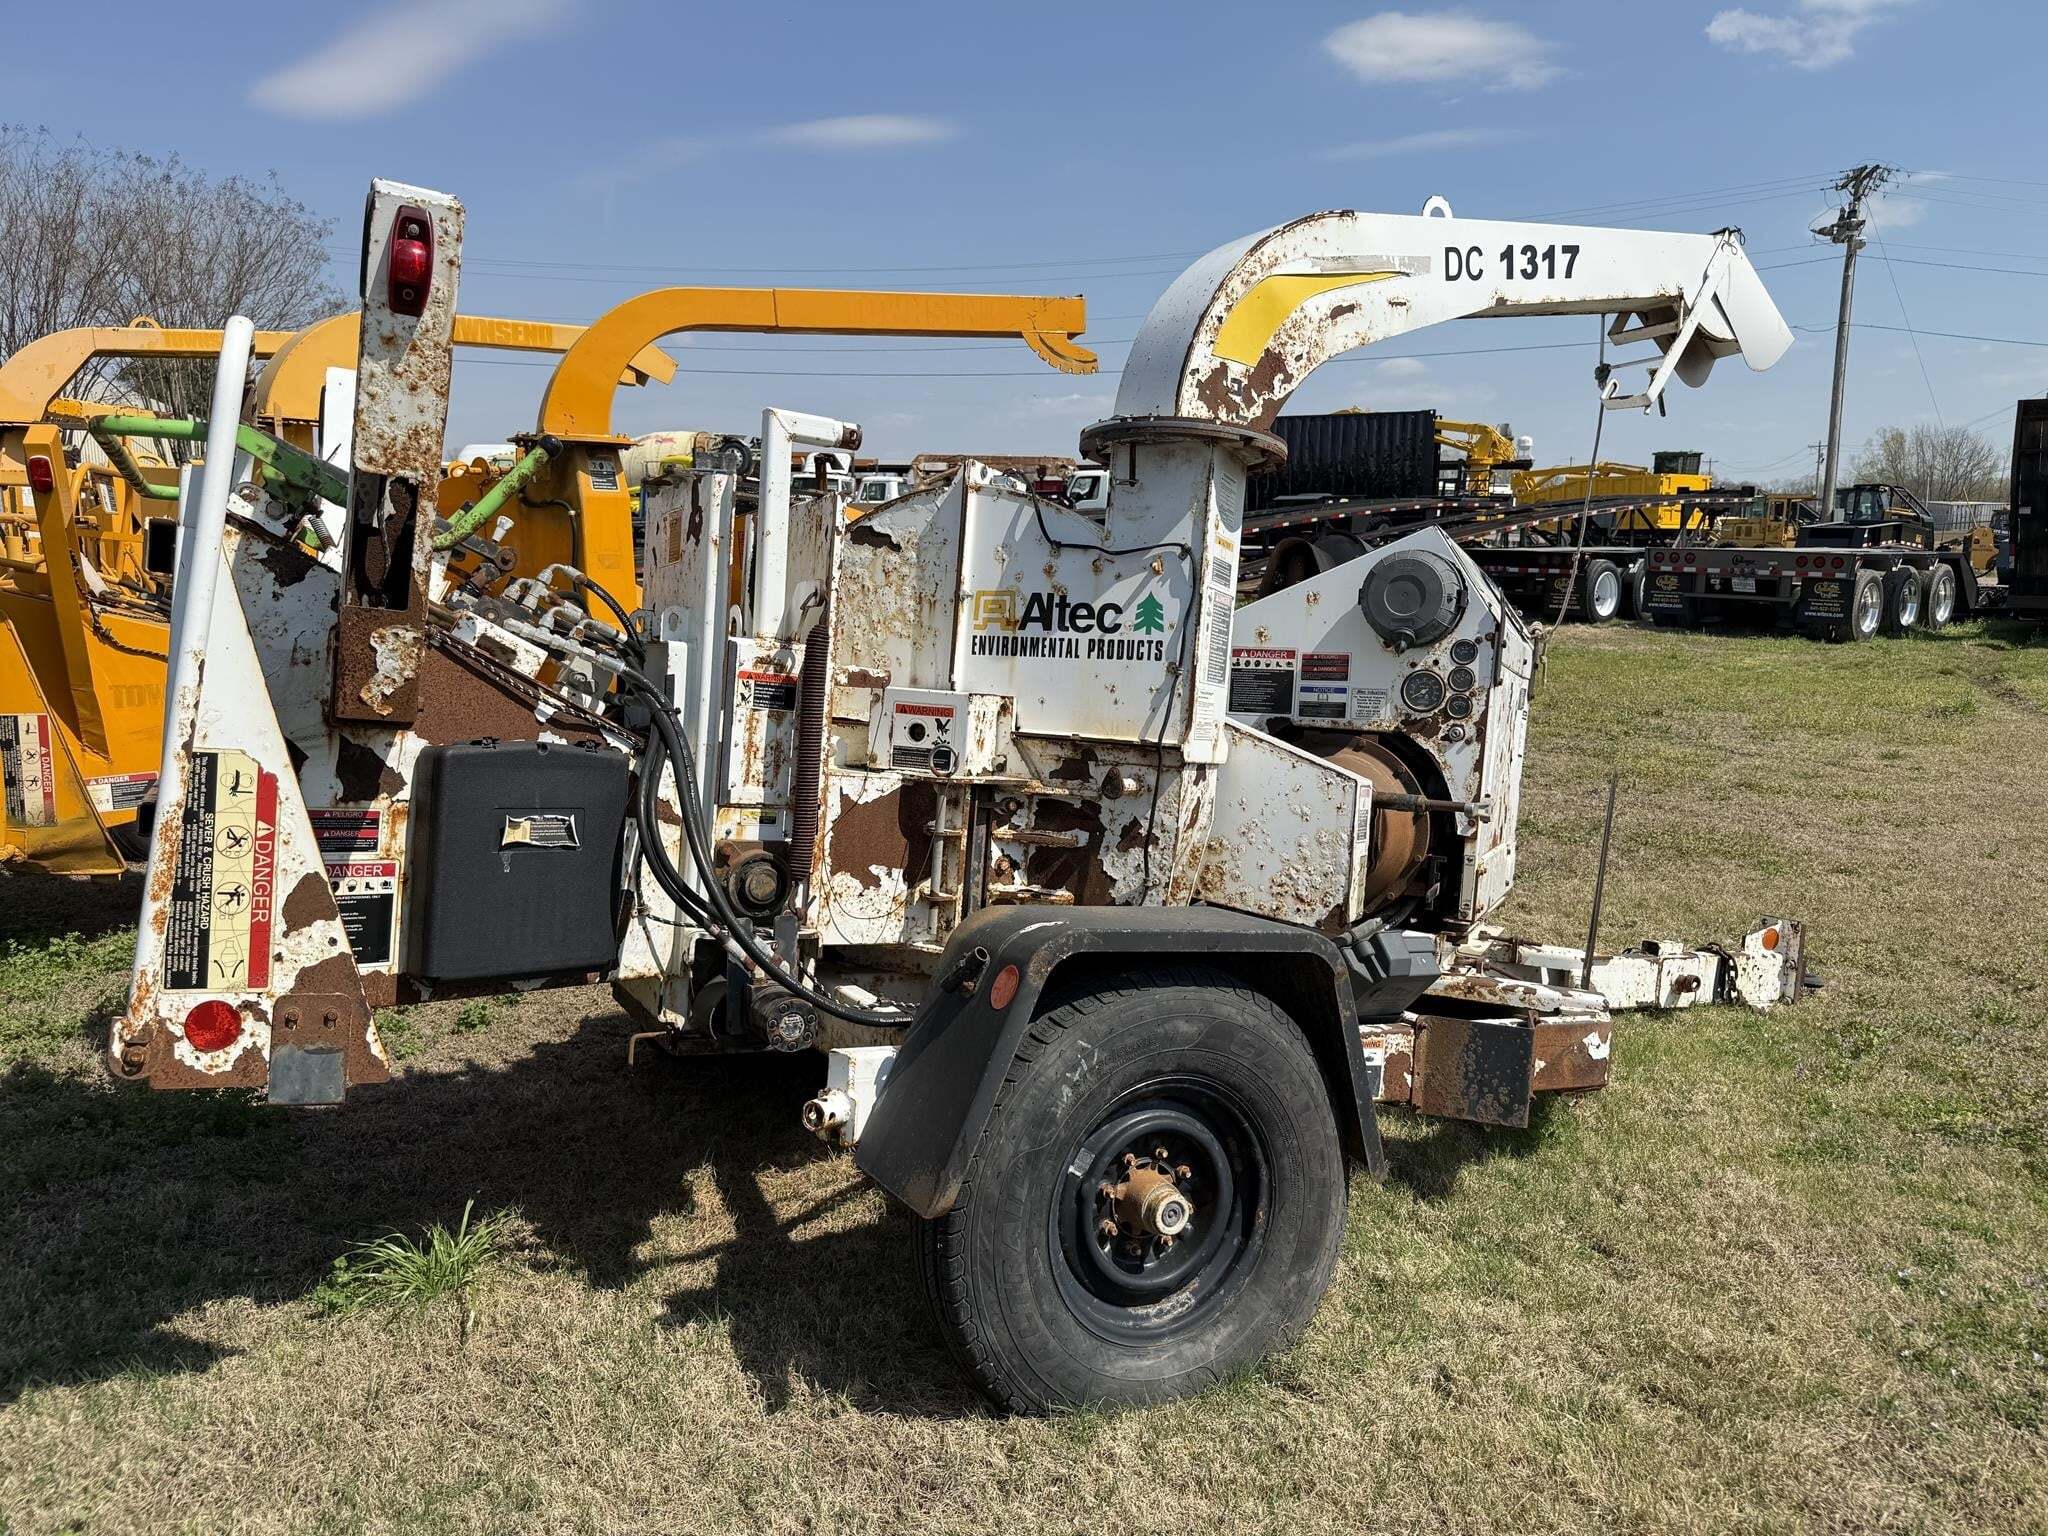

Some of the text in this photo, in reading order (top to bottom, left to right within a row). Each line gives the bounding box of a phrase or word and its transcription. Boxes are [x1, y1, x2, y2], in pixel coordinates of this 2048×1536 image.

[1445, 244, 1580, 281] DC 1317
[1018, 592, 1123, 634] Altec
[972, 635, 1163, 661] ENVIRONMENTAL PRODUCTS
[908, 705, 953, 717] WARNING
[41, 757, 51, 793] DANGER
[98, 776, 129, 784] DANGER
[204, 813, 214, 842] SEVER
[202, 857, 212, 888] CRUSH
[251, 840, 272, 923] DANGER
[326, 866, 383, 876] DANGER
[200, 892, 211, 929] HAZARD
